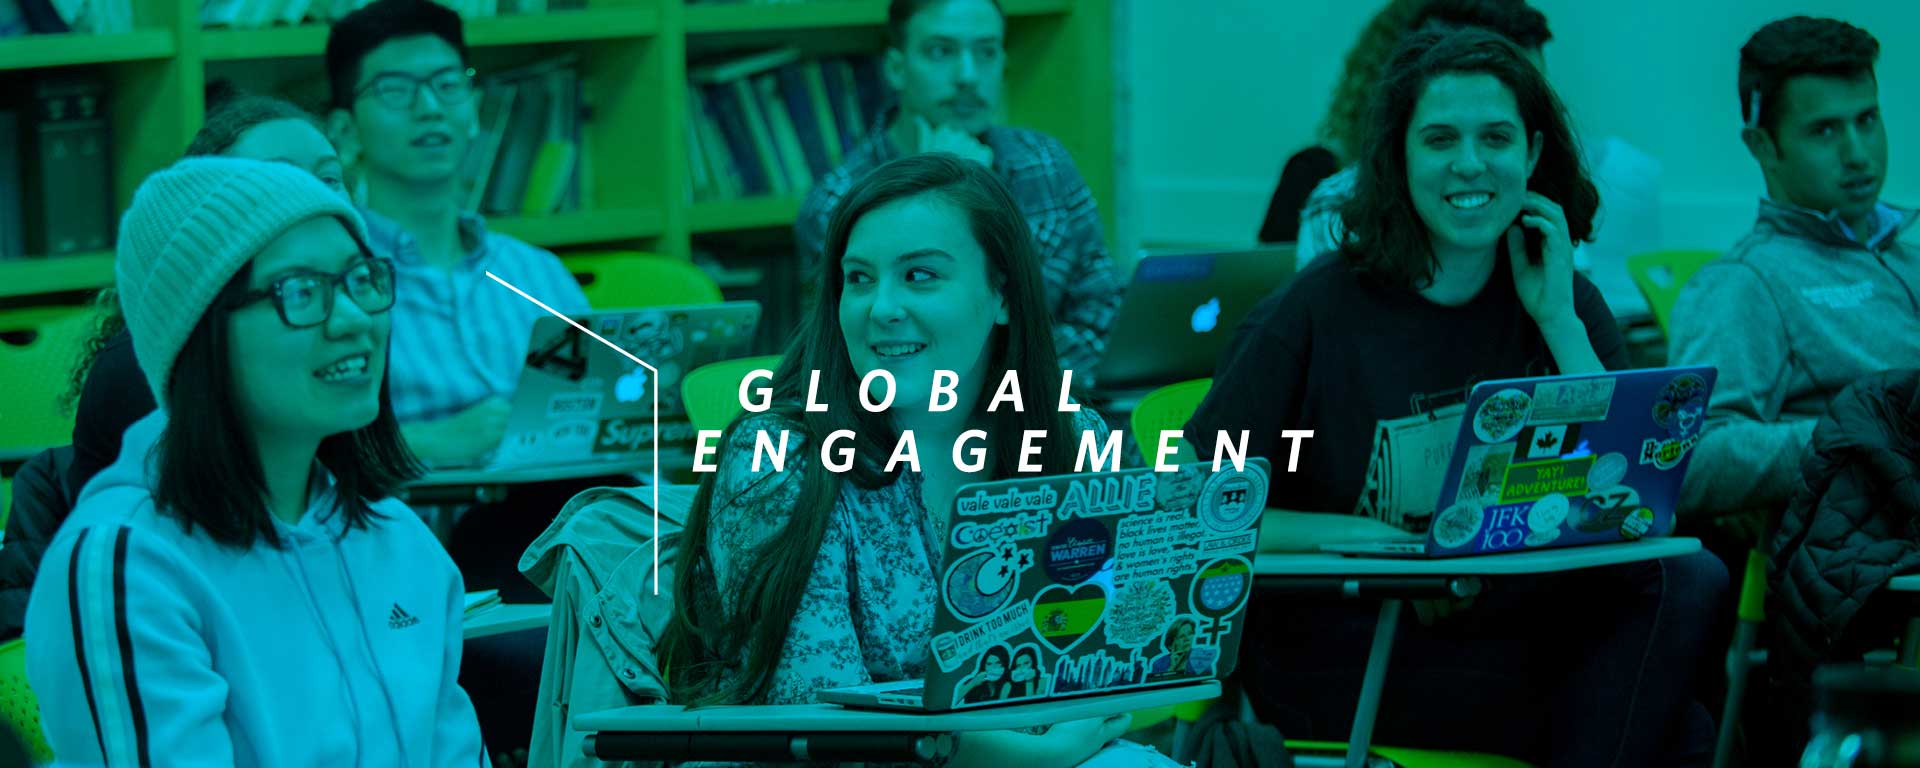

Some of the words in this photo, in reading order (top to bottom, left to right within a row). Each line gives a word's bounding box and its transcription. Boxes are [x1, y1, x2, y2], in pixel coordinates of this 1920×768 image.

[1536, 465, 1565, 480] YAY!
[1506, 475, 1586, 498] ADVENTURE!
[961, 495, 990, 512] vale
[994, 490, 1022, 509] vale
[1025, 487, 1053, 507] vale
[1059, 475, 1155, 518] ALLIE
[1121, 517, 1154, 529] science
[1488, 505, 1530, 531] JFK
[1119, 526, 1144, 539] black
[1147, 525, 1167, 536] lives
[1481, 528, 1523, 551] 100
[1119, 542, 1130, 550] no
[1133, 537, 1164, 549] human
[1051, 544, 1106, 562] WARREN
[1117, 551, 1136, 561] love
[1115, 561, 1123, 572] &
[1127, 557, 1167, 569] women's
[1114, 574, 1130, 582] are
[1132, 568, 1164, 579] human
[957, 626, 985, 647] DRINK
[985, 617, 1003, 632] TOO
[1003, 603, 1029, 624] MUCH
